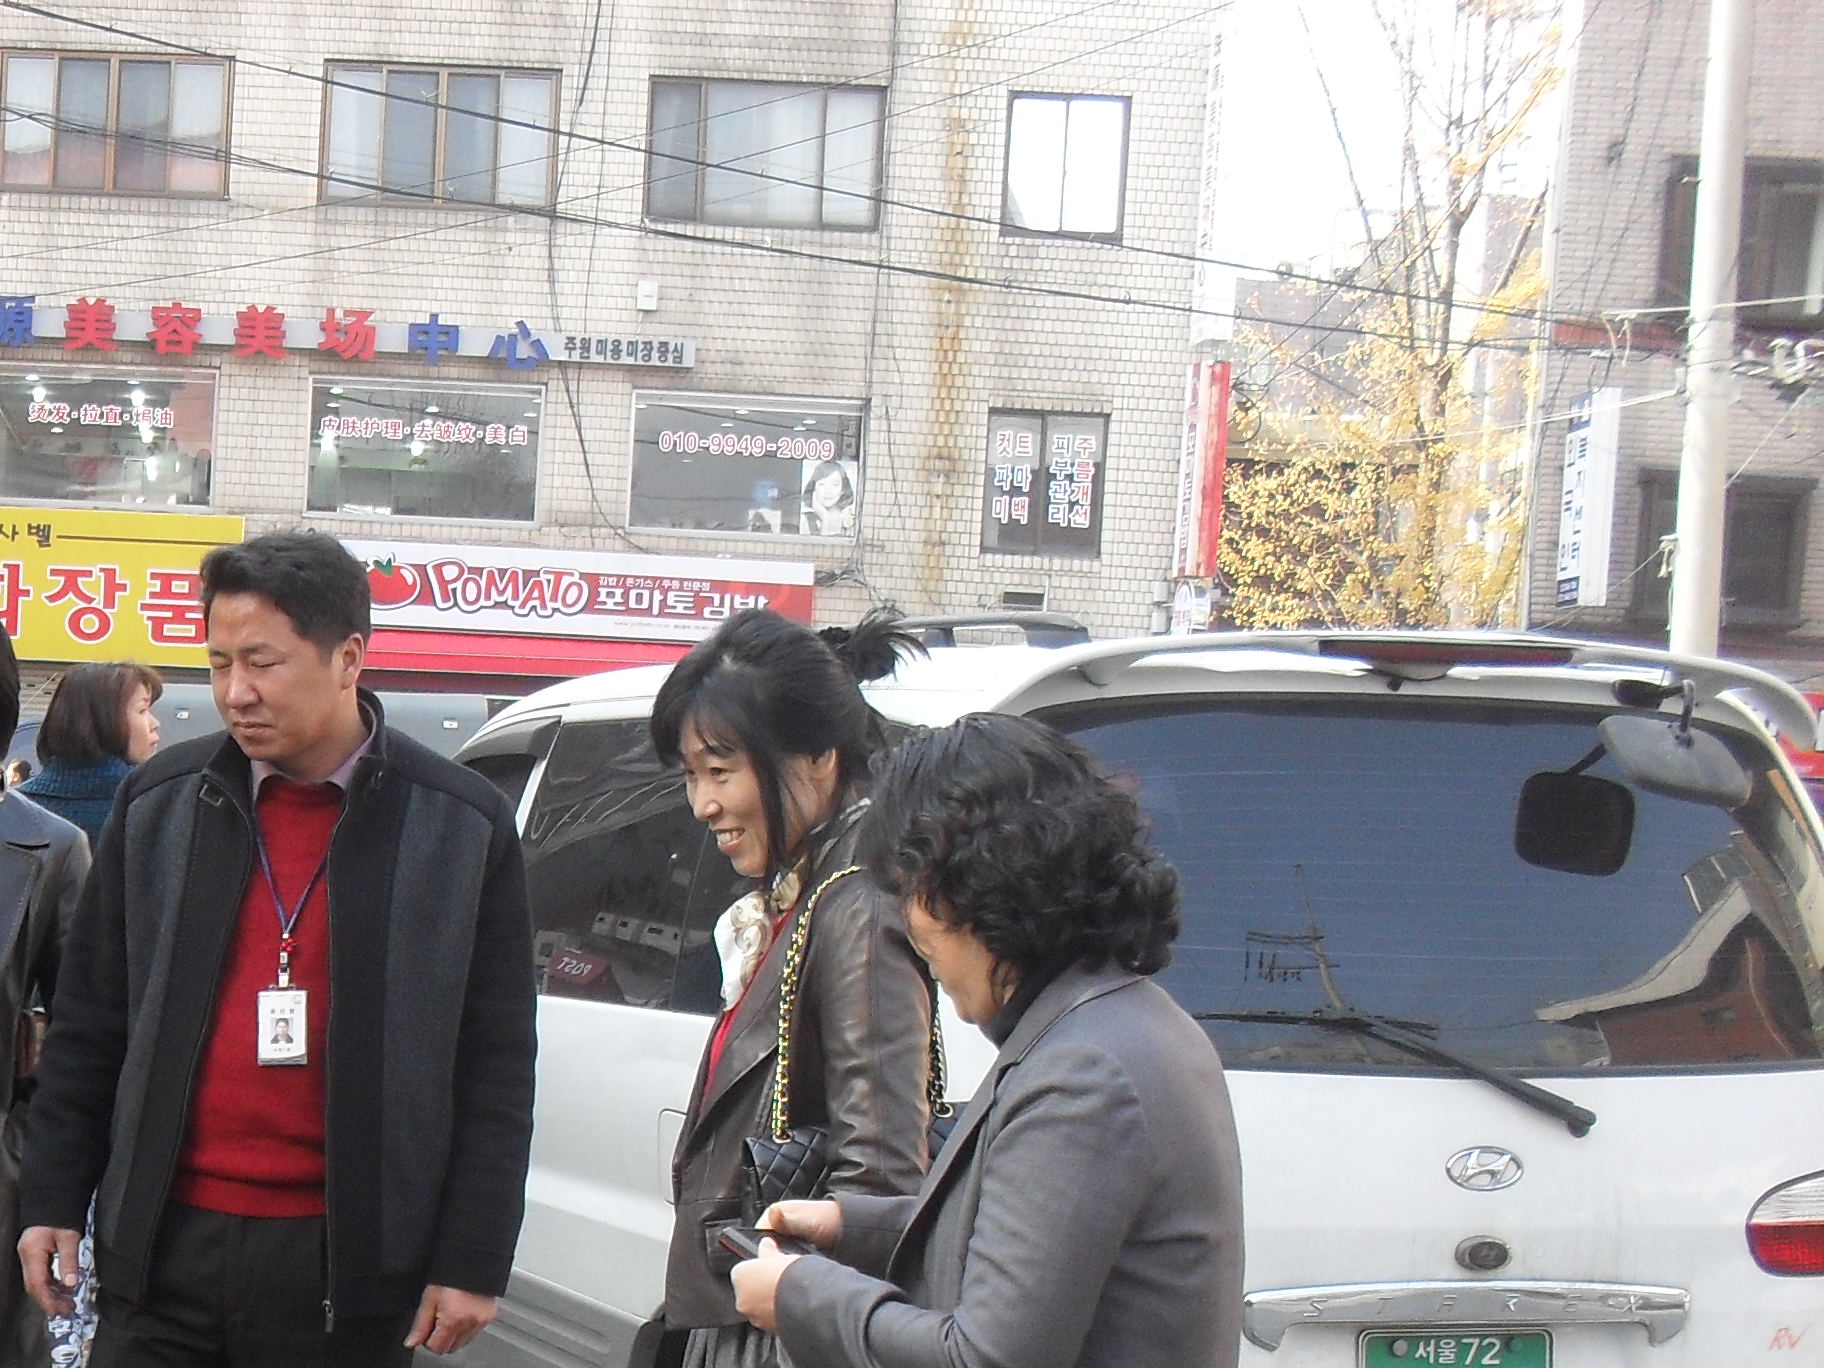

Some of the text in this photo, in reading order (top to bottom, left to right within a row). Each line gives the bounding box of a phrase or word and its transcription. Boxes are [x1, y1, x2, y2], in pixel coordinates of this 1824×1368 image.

[659, 430, 835, 461] 010-9949-2009
[997, 432, 1033, 457] 컷트
[994, 464, 1032, 492] 파마
[992, 496, 1029, 524] 미백
[1415, 1338, 1500, 1365] 서울 72
